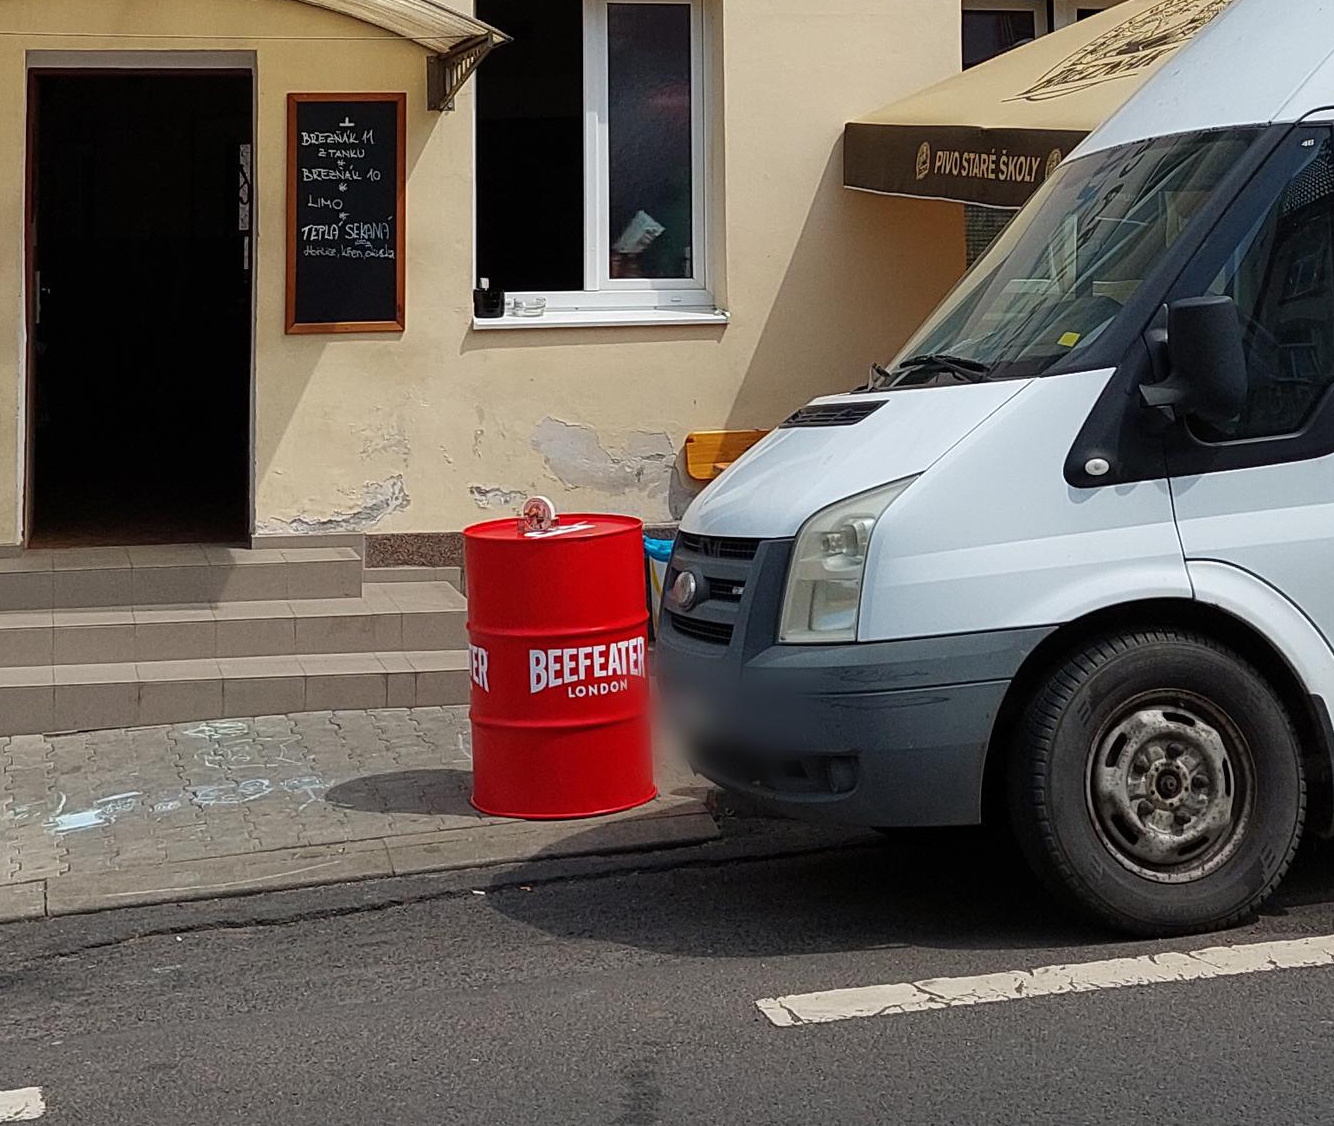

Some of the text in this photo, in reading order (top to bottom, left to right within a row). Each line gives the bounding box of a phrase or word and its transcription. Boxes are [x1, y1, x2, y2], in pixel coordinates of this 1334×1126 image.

[362, 129, 374, 145] 11
[328, 148, 365, 158] TANKU
[367, 168, 381, 181] 10
[934, 150, 960, 175] PIVO
[961, 149, 996, 179] STARÉ
[999, 149, 1041, 183] ŠKOLY
[308, 194, 343, 210] LIMO
[301, 216, 393, 241] TEPLÁ SEKANÁ
[529, 636, 646, 694] BEEFEATER
[568, 679, 628, 698] LONDON
